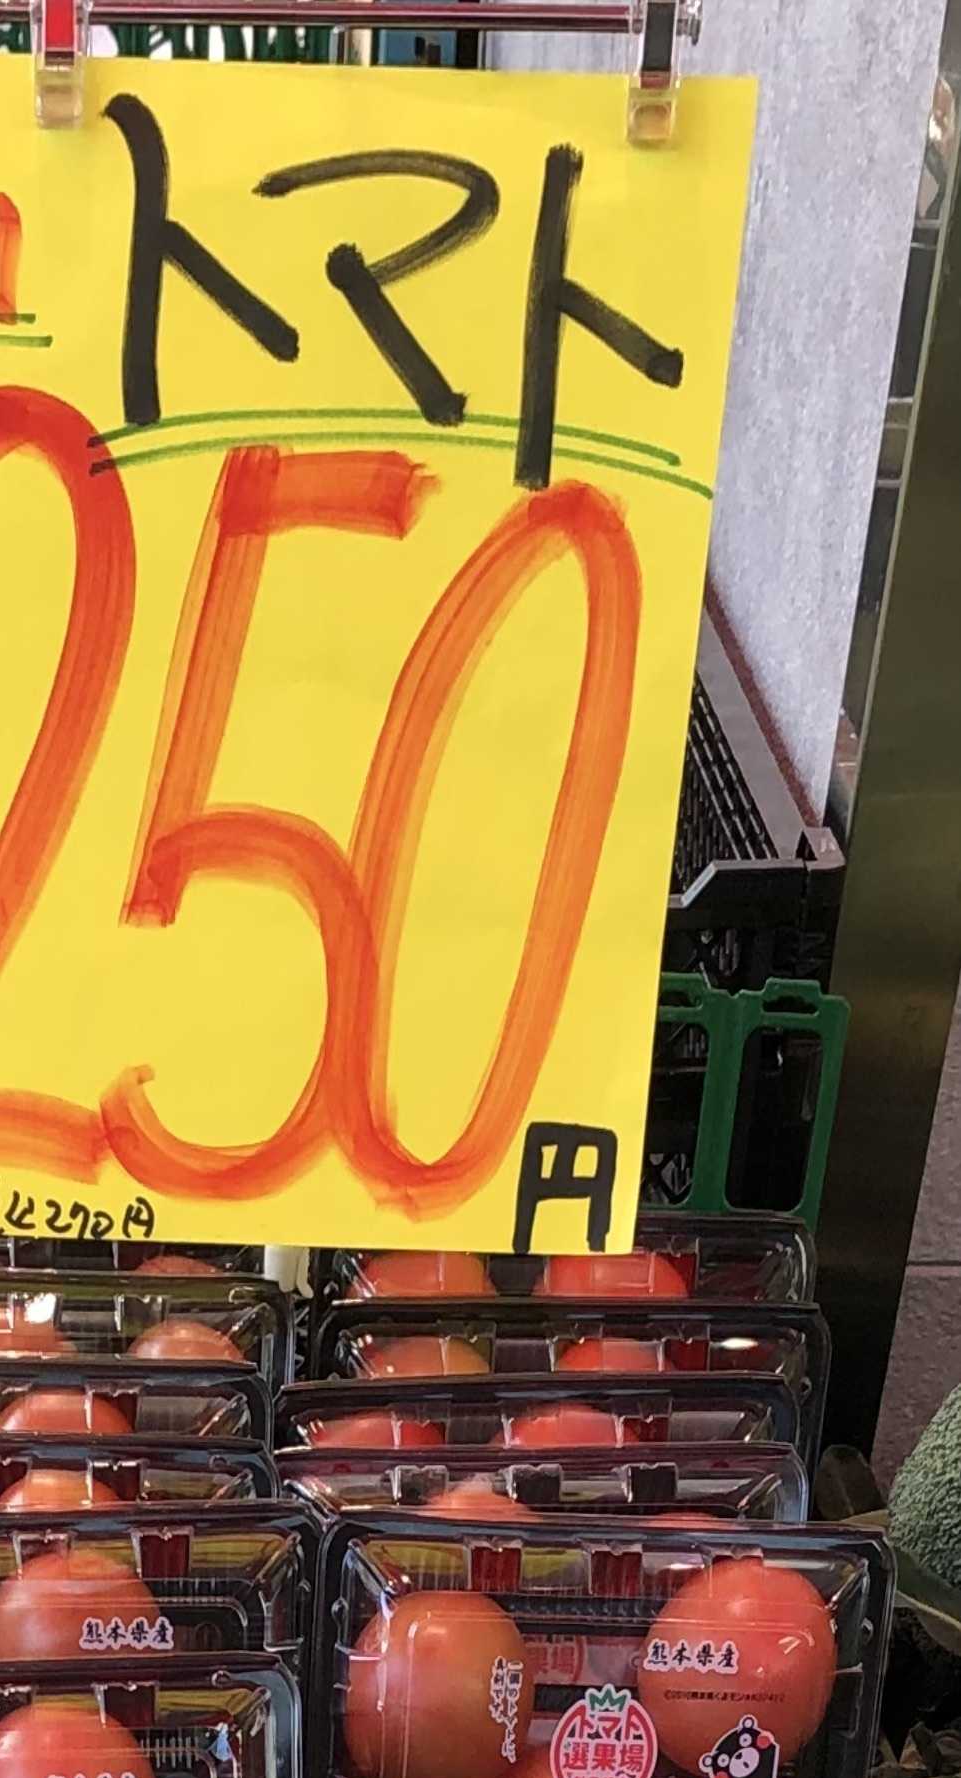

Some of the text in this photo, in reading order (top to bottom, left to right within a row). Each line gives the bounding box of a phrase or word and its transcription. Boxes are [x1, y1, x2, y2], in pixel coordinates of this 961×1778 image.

[103, 93, 684, 489] トマト
[84, 1620, 171, 1645] 熊本県産
[646, 1642, 737, 1670] 熊本県産
[575, 1713, 642, 1739] トマト
[563, 1743, 645, 1772] 選果場
